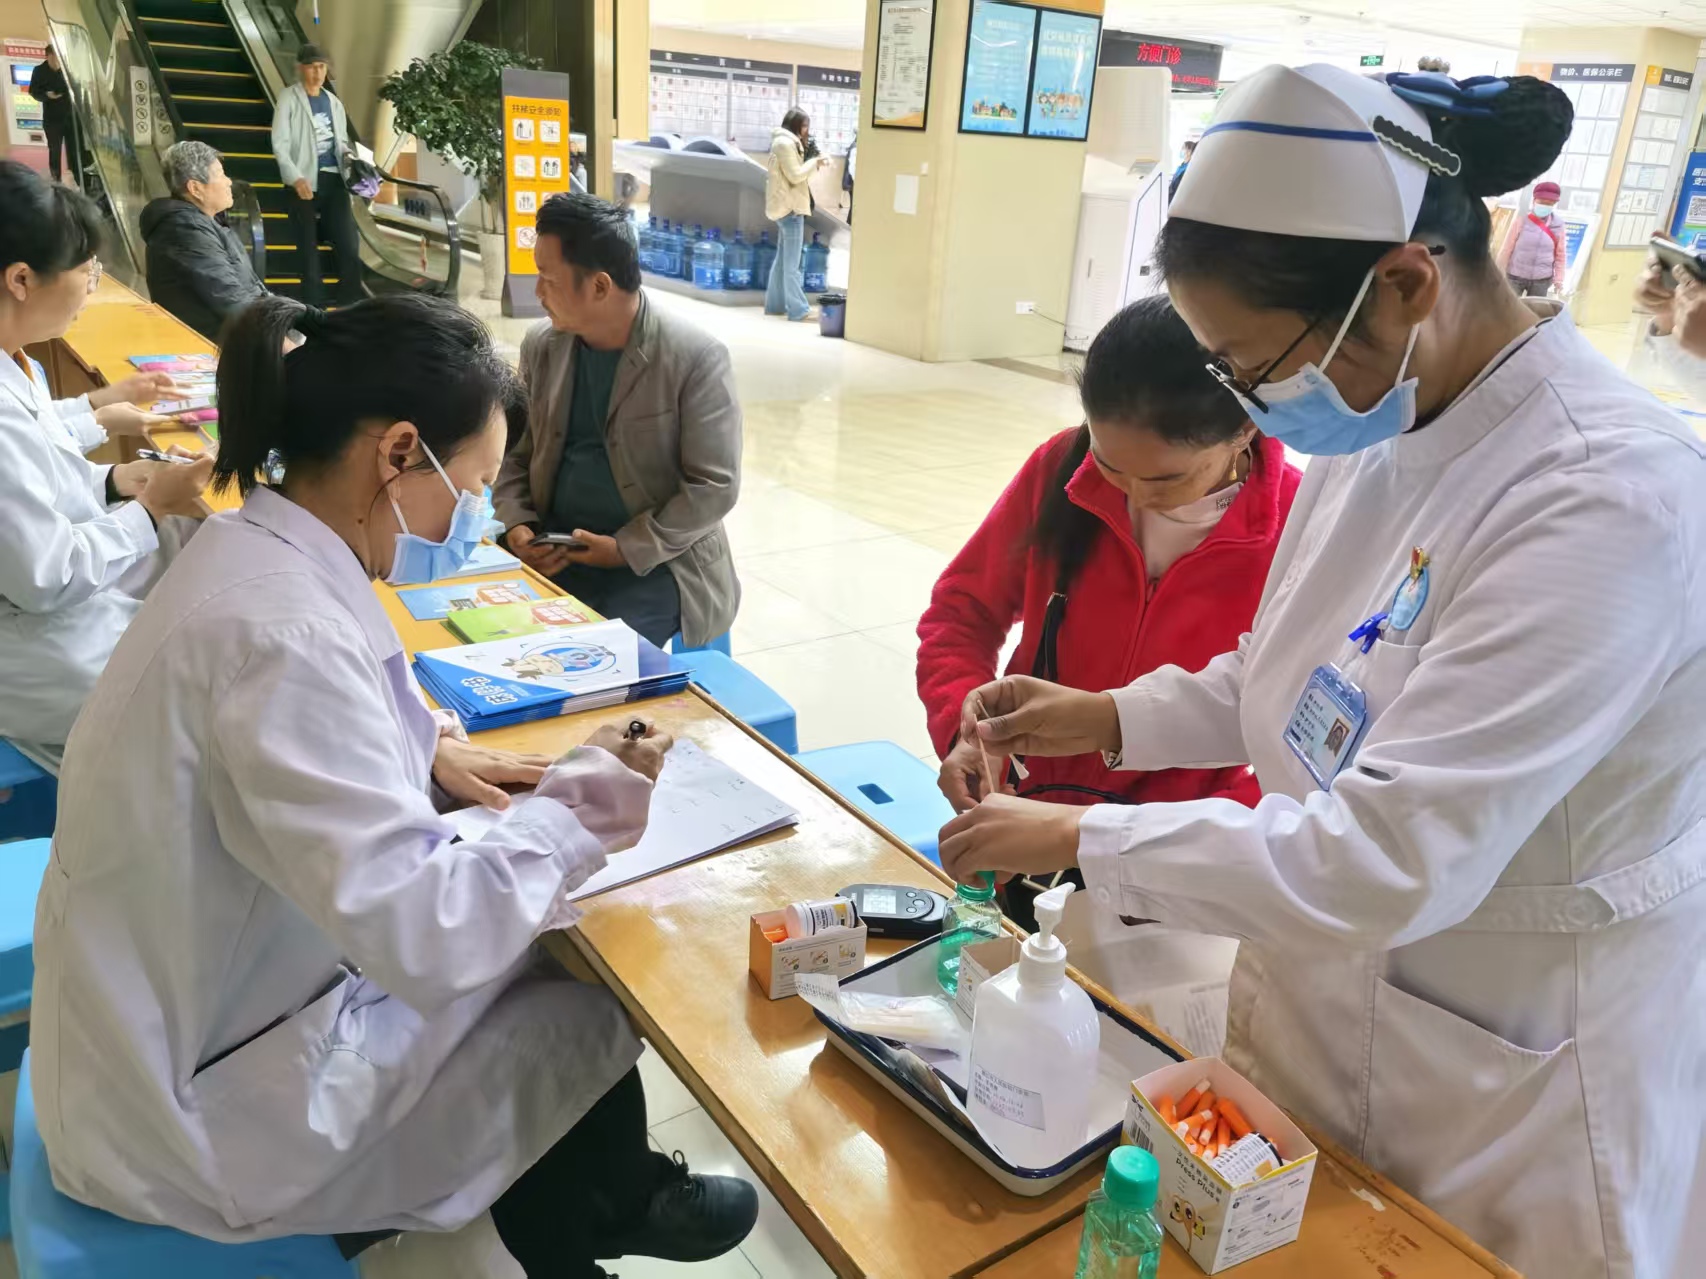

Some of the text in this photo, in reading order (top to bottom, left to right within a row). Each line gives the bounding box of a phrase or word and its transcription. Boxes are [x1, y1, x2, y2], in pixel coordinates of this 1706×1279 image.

[1136, 42, 1182, 65] 方便门诊
[1559, 67, 1623, 77] 物价、医保公示栏
[1176, 1157, 1196, 1181] Press
[1197, 1179, 1215, 1198] Plus
